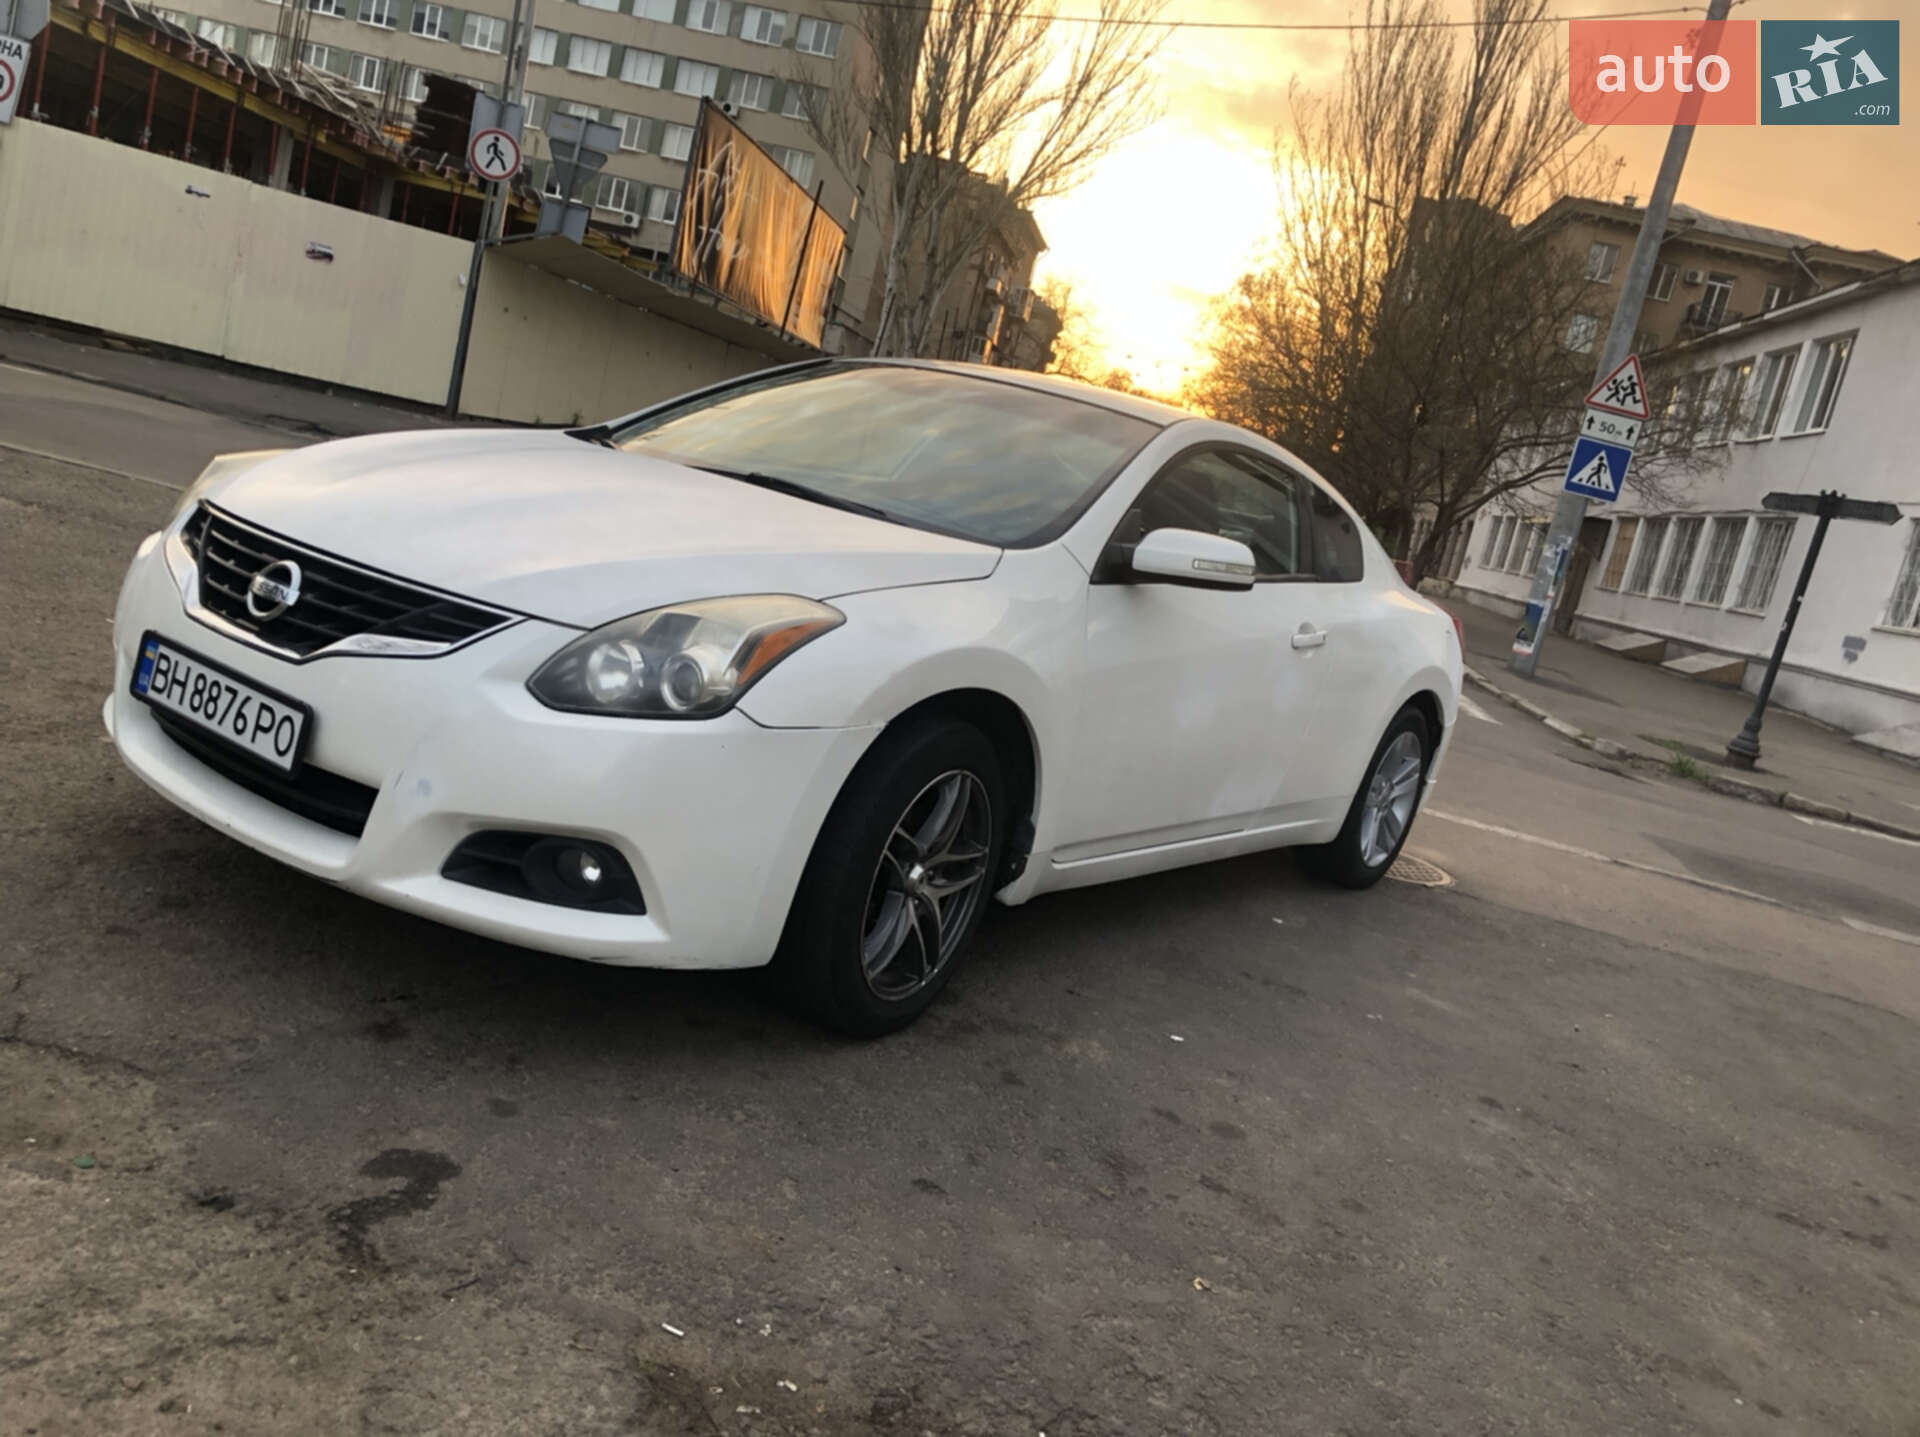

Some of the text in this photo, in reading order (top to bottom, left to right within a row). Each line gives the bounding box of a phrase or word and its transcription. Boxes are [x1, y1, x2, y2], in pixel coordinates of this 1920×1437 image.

[0, 39, 22, 60] НА
[1599, 421, 1616, 434] 50
[150, 652, 295, 757] BH 8876 PO
